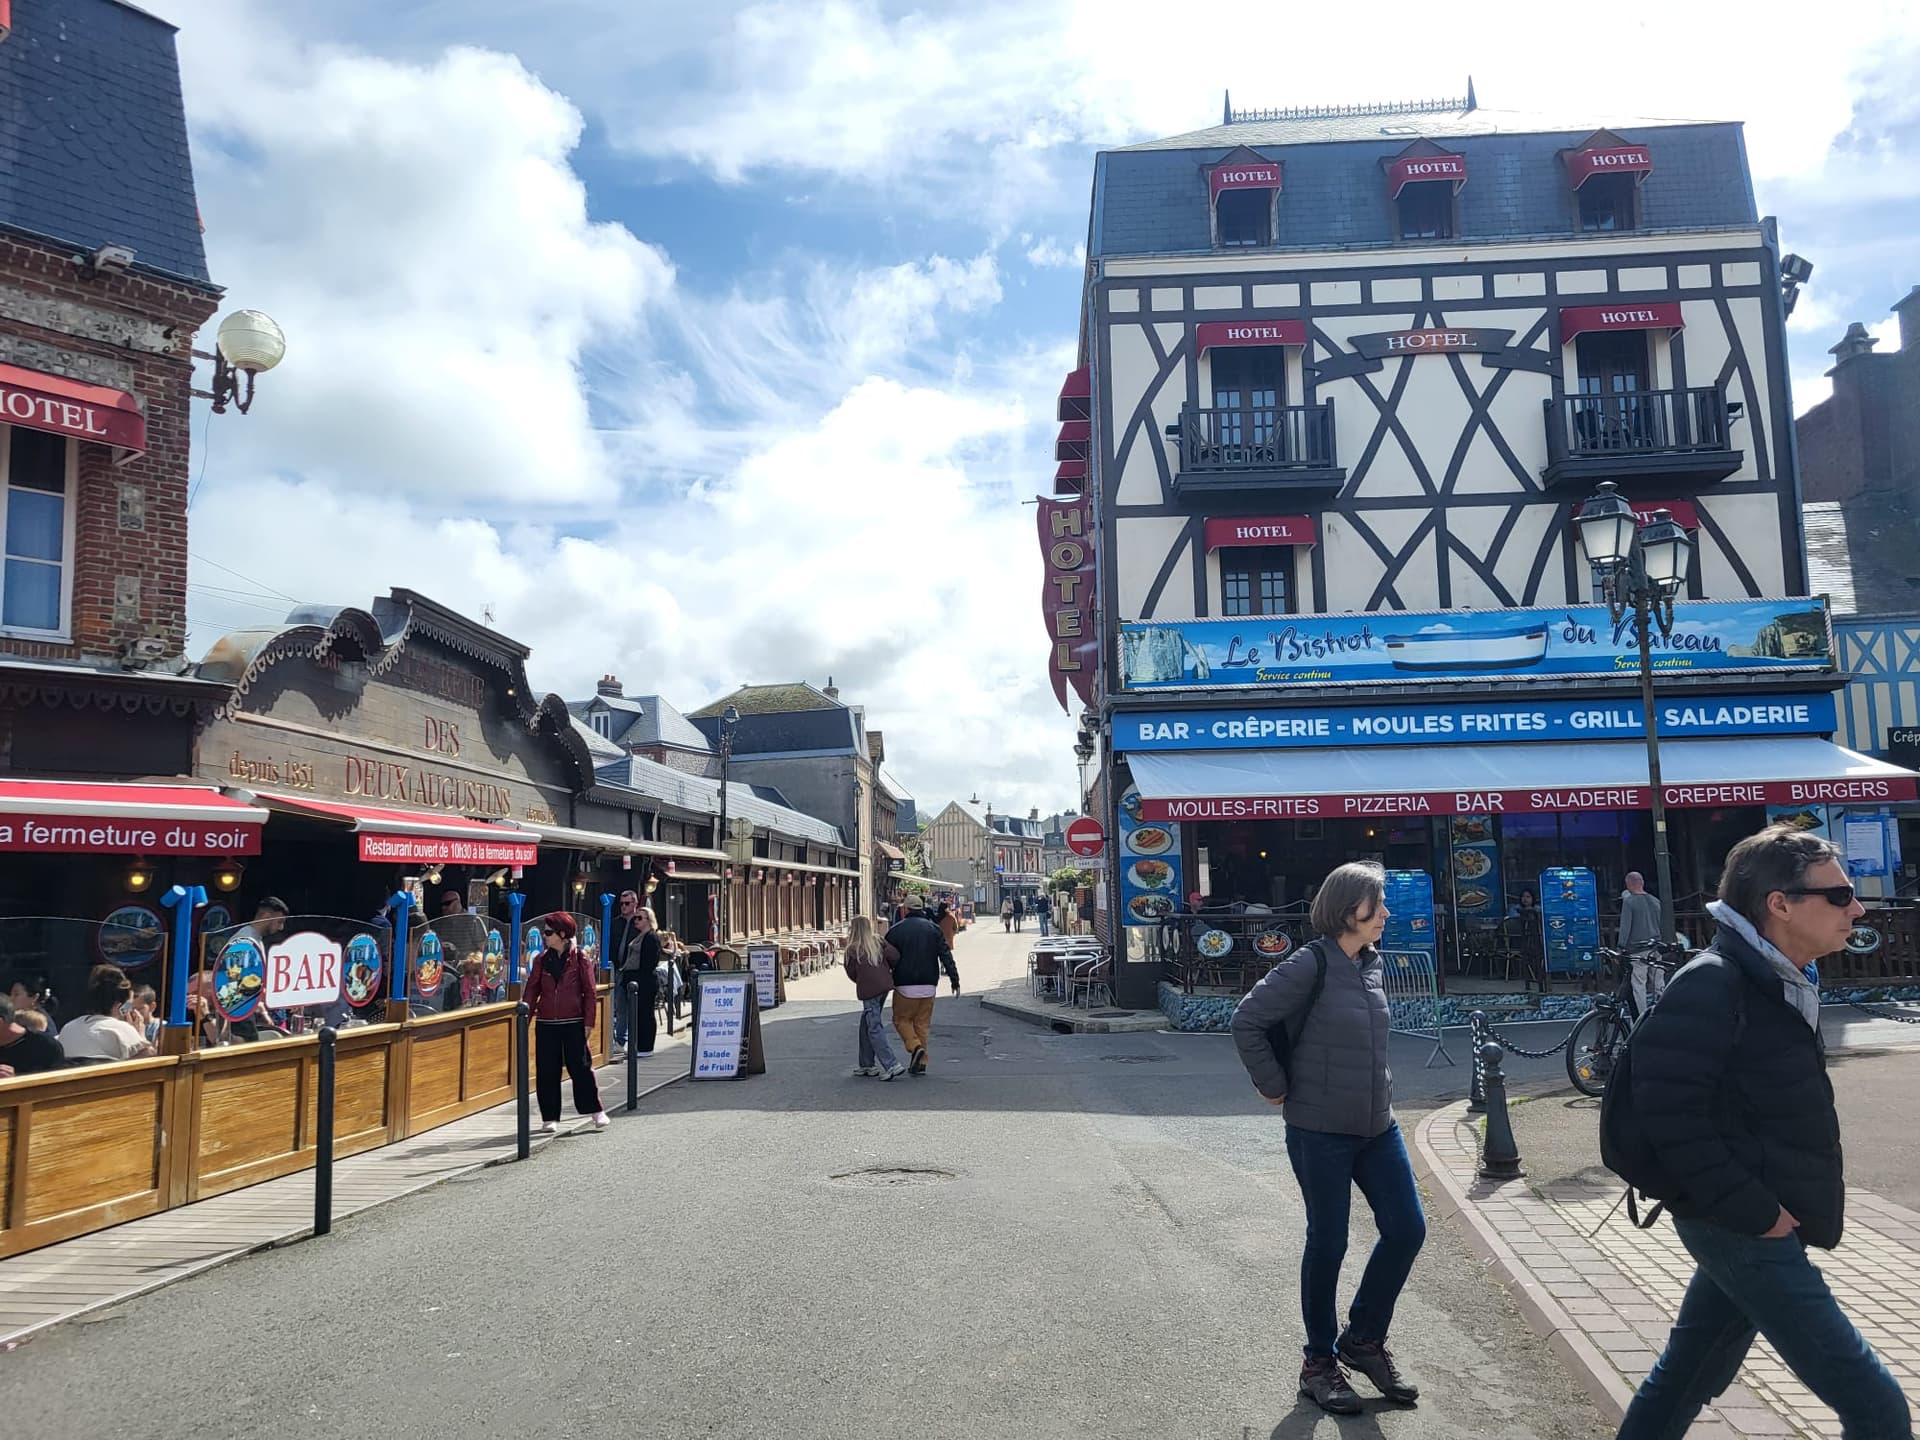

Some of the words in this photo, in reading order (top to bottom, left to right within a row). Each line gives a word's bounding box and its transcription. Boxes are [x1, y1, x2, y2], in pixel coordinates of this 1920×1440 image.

[1592, 154, 1649, 166] HOTEL
[1222, 170, 1276, 183] HOTEL
[1407, 163, 1462, 175] HOTEL
[1601, 310, 1658, 323] HOTEL
[1227, 327, 1282, 339] HOTEL
[1386, 333, 1477, 350] HOTEL
[1236, 525, 1292, 539] HOTEL
[1050, 508, 1083, 671] HOTEL
[1221, 635, 1260, 668] Le
[1269, 624, 1373, 662] Bistrot
[1563, 614, 1597, 644] du
[1653, 656, 1693, 667] continu
[1256, 667, 1290, 681] Service
[1293, 669, 1331, 680] continu
[1139, 723, 1189, 740] BAR
[1212, 716, 1331, 739] CRÊPERIE
[1353, 715, 1453, 735] MOULES
[1461, 713, 1547, 732] FRITES
[1570, 710, 1642, 728] GRILL
[1665, 705, 1809, 726] SALADERIE
[424, 716, 460, 757] DES
[229, 751, 279, 784] depuis
[343, 756, 407, 801] DEUX
[415, 770, 511, 818] AUGUSTINS
[1168, 799, 1319, 818] MOULES-FRITES
[1344, 797, 1430, 813] PIZZERIA
[1456, 793, 1503, 811] BAR
[1530, 790, 1639, 809] SALADERIE
[1665, 785, 1765, 804] CREPERIE
[1791, 781, 1889, 800] BURGERS
[23, 821, 156, 847] fermeture
[165, 827, 195, 847] du
[204, 829, 249, 849] soir
[365, 837, 412, 856] Restaurant
[414, 844, 438, 858] ouvert
[439, 845, 449, 858] de
[451, 844, 471, 859] 10h30
[473, 846, 477, 859] à
[479, 847, 485, 859] la
[486, 846, 514, 860] fermeture
[516, 848, 523, 860] du
[524, 849, 534, 861] soir
[273, 953, 337, 993] BAR
[703, 1050, 731, 1058] Salade
[699, 1063, 709, 1071] de
[711, 1063, 734, 1071] Fruits
